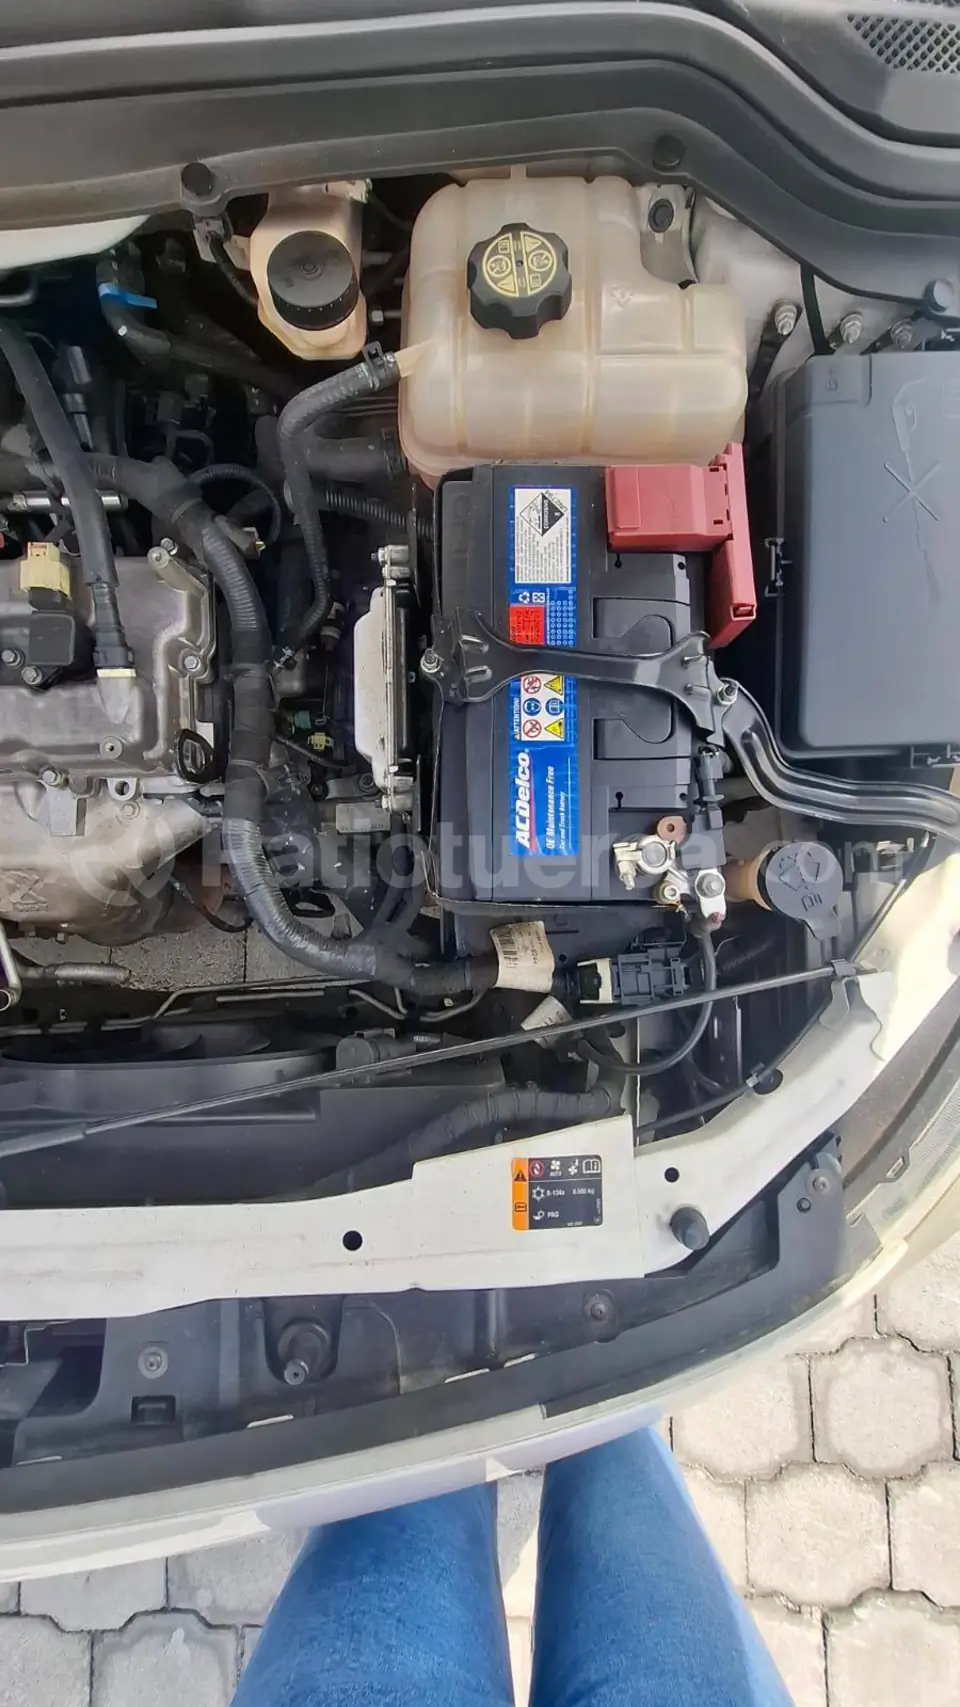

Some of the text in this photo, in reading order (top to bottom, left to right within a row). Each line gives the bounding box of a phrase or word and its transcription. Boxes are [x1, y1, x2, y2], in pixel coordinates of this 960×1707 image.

[515, 752, 530, 848] ACDelco
[545, 766, 555, 849] OE Maintenance Free
[559, 791, 567, 812] Battery
